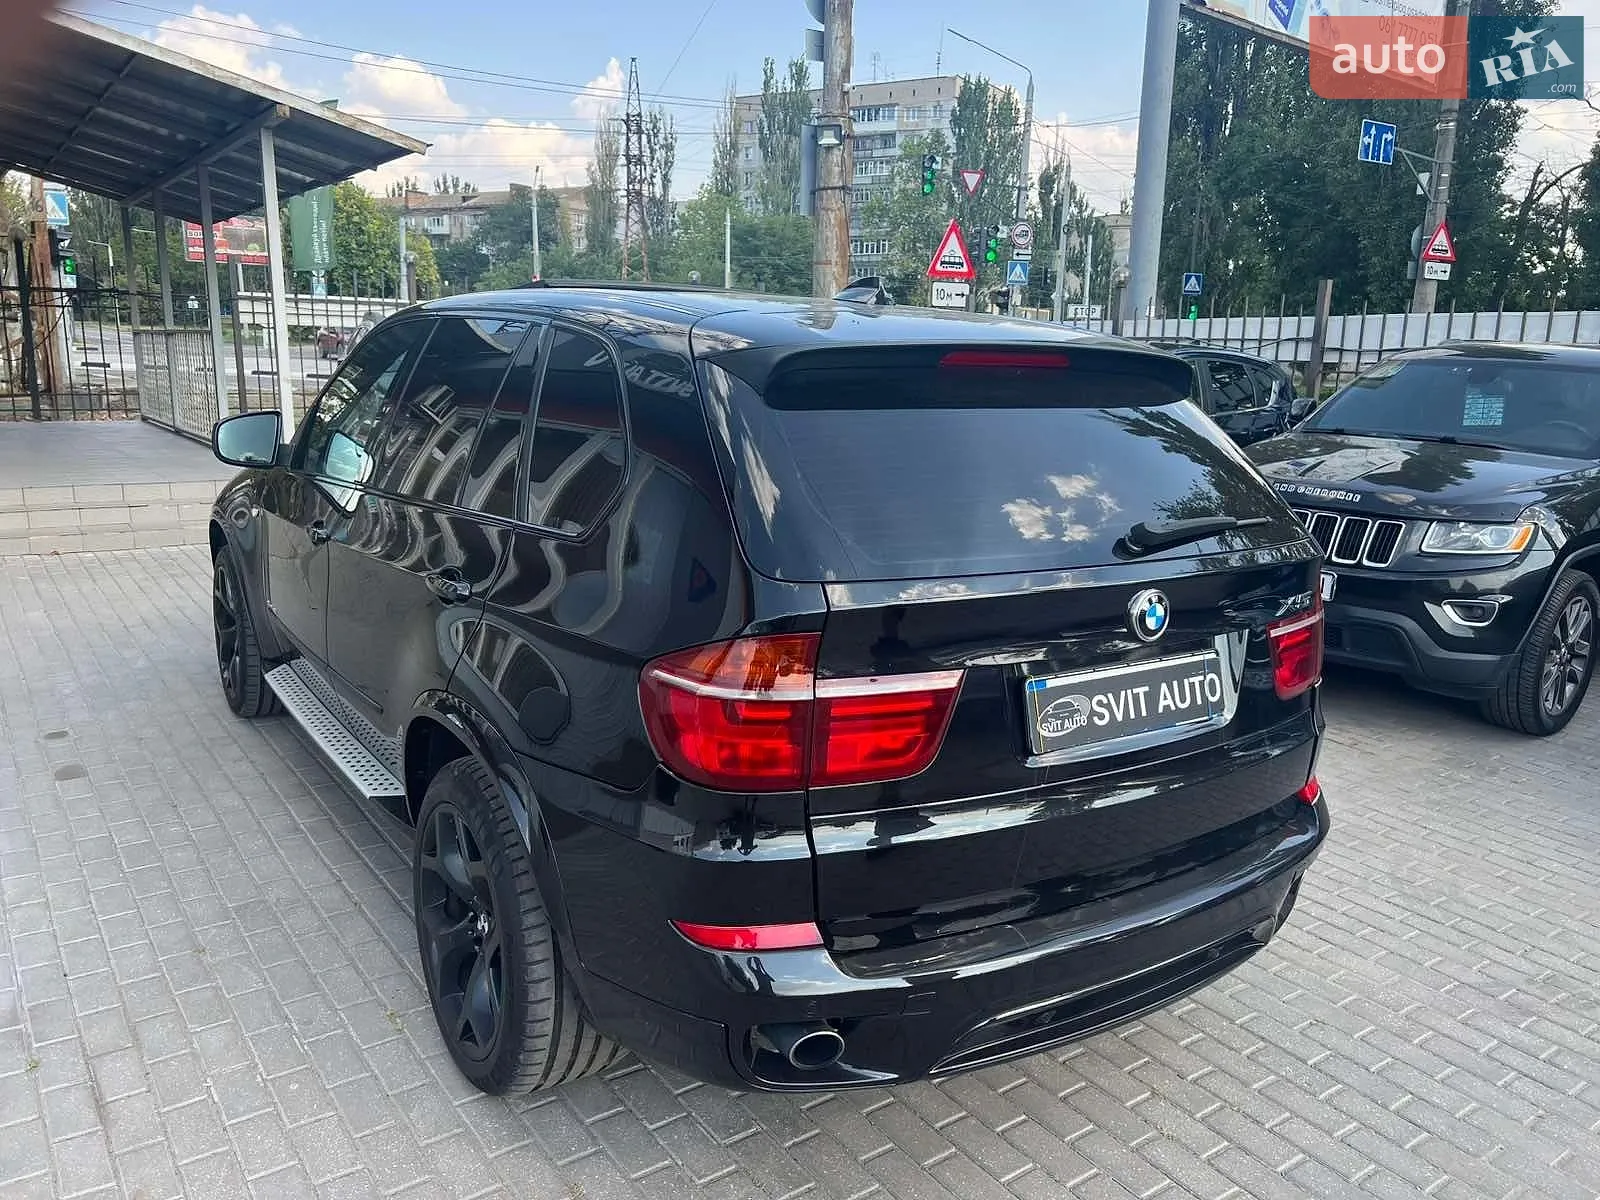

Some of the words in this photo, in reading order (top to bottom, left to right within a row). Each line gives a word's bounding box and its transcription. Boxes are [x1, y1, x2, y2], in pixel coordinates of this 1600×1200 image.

[1073, 307, 1097, 316] STOP
[1273, 483, 1295, 492] AND
[1092, 686, 1149, 726] SVIT
[1158, 672, 1221, 714] AUTO
[1041, 718, 1062, 733] SVIT
[1063, 715, 1088, 730] AUTO
